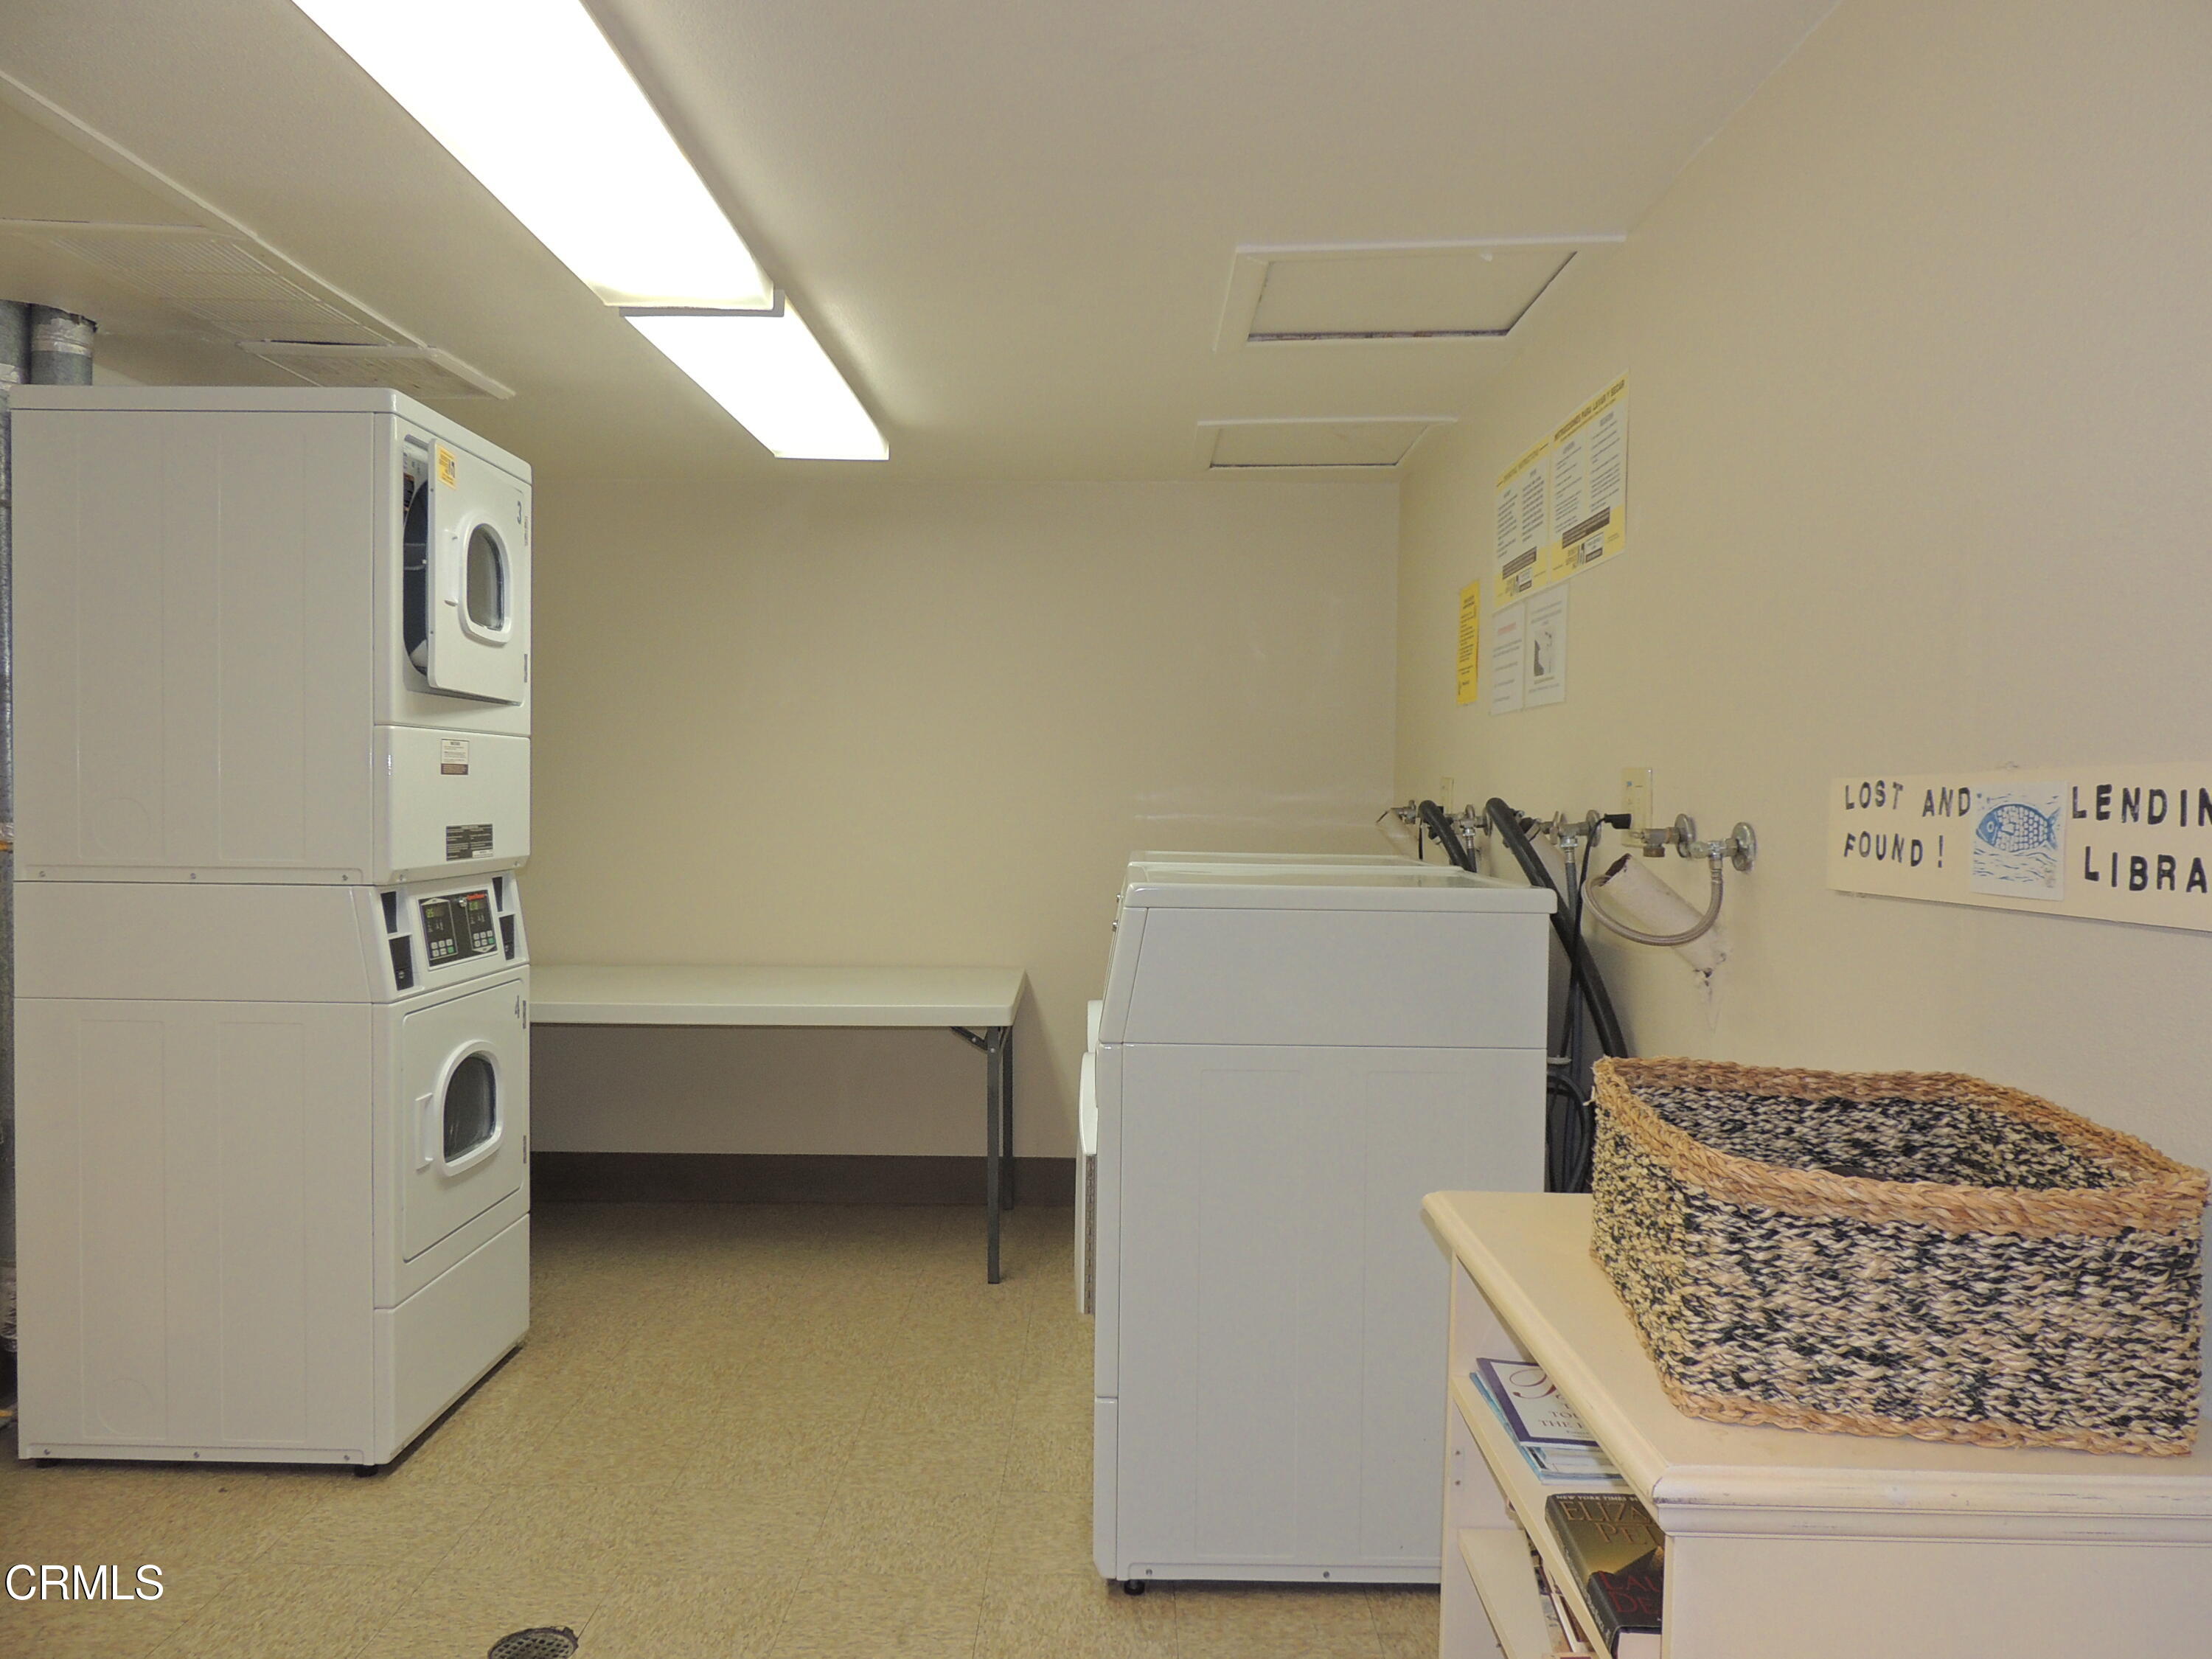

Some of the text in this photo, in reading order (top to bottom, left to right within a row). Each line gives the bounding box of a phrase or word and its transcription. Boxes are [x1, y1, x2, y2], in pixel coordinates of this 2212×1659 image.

[1845, 779, 1971, 818] LOST AND
[2072, 784, 2212, 827] LENDIN
[2084, 846, 2208, 894] LIBRA
